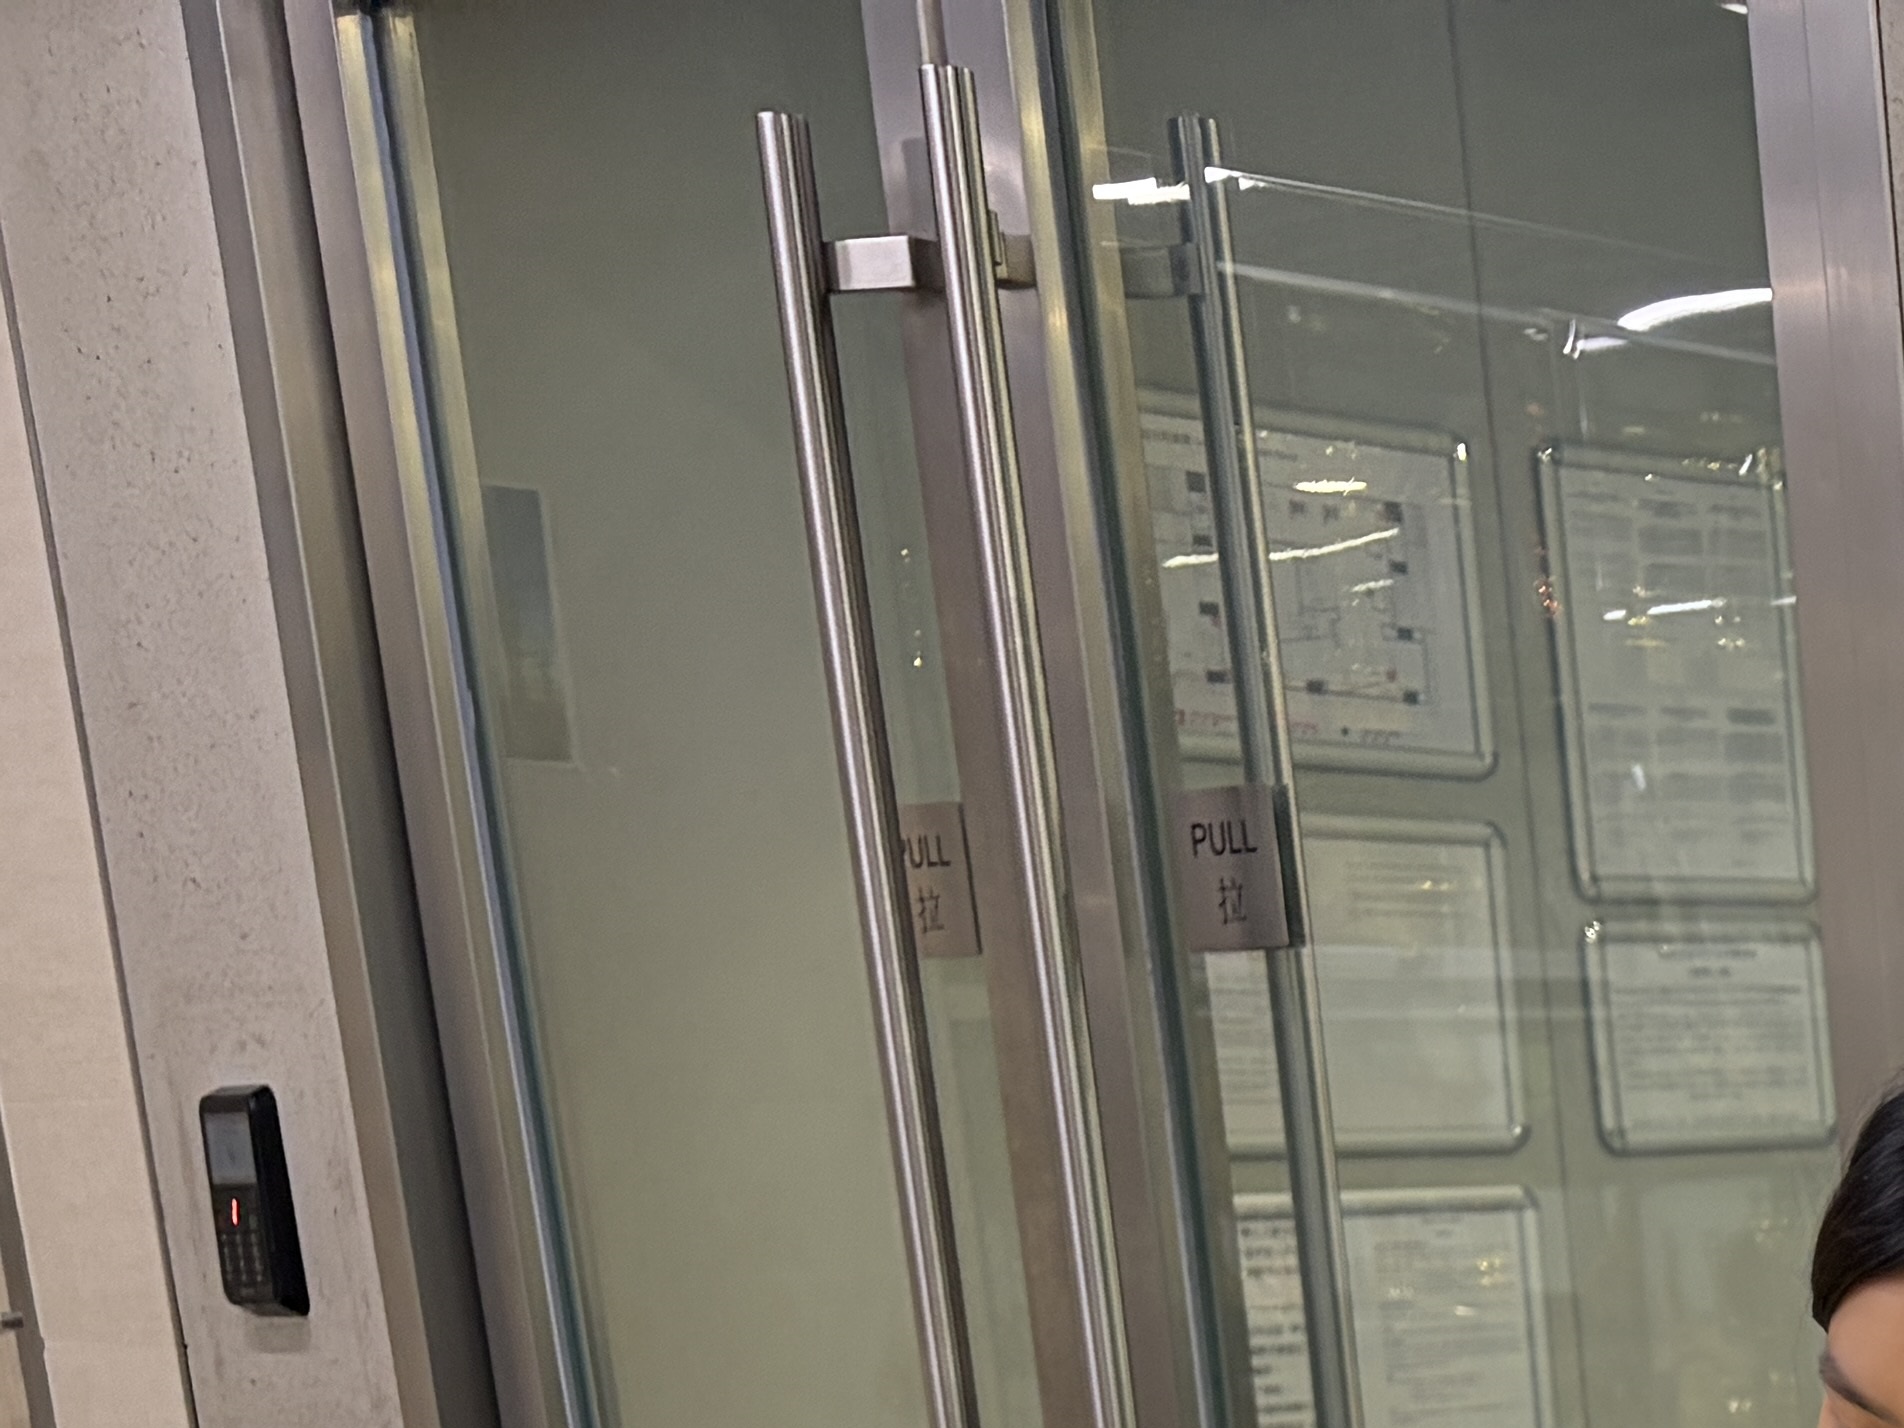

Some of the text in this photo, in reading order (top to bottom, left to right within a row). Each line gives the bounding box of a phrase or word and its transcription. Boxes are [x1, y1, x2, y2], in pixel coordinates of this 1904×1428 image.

[1190, 821, 1258, 859] PULL
[914, 885, 945, 935] 拉
[1216, 877, 1247, 926] 拉
